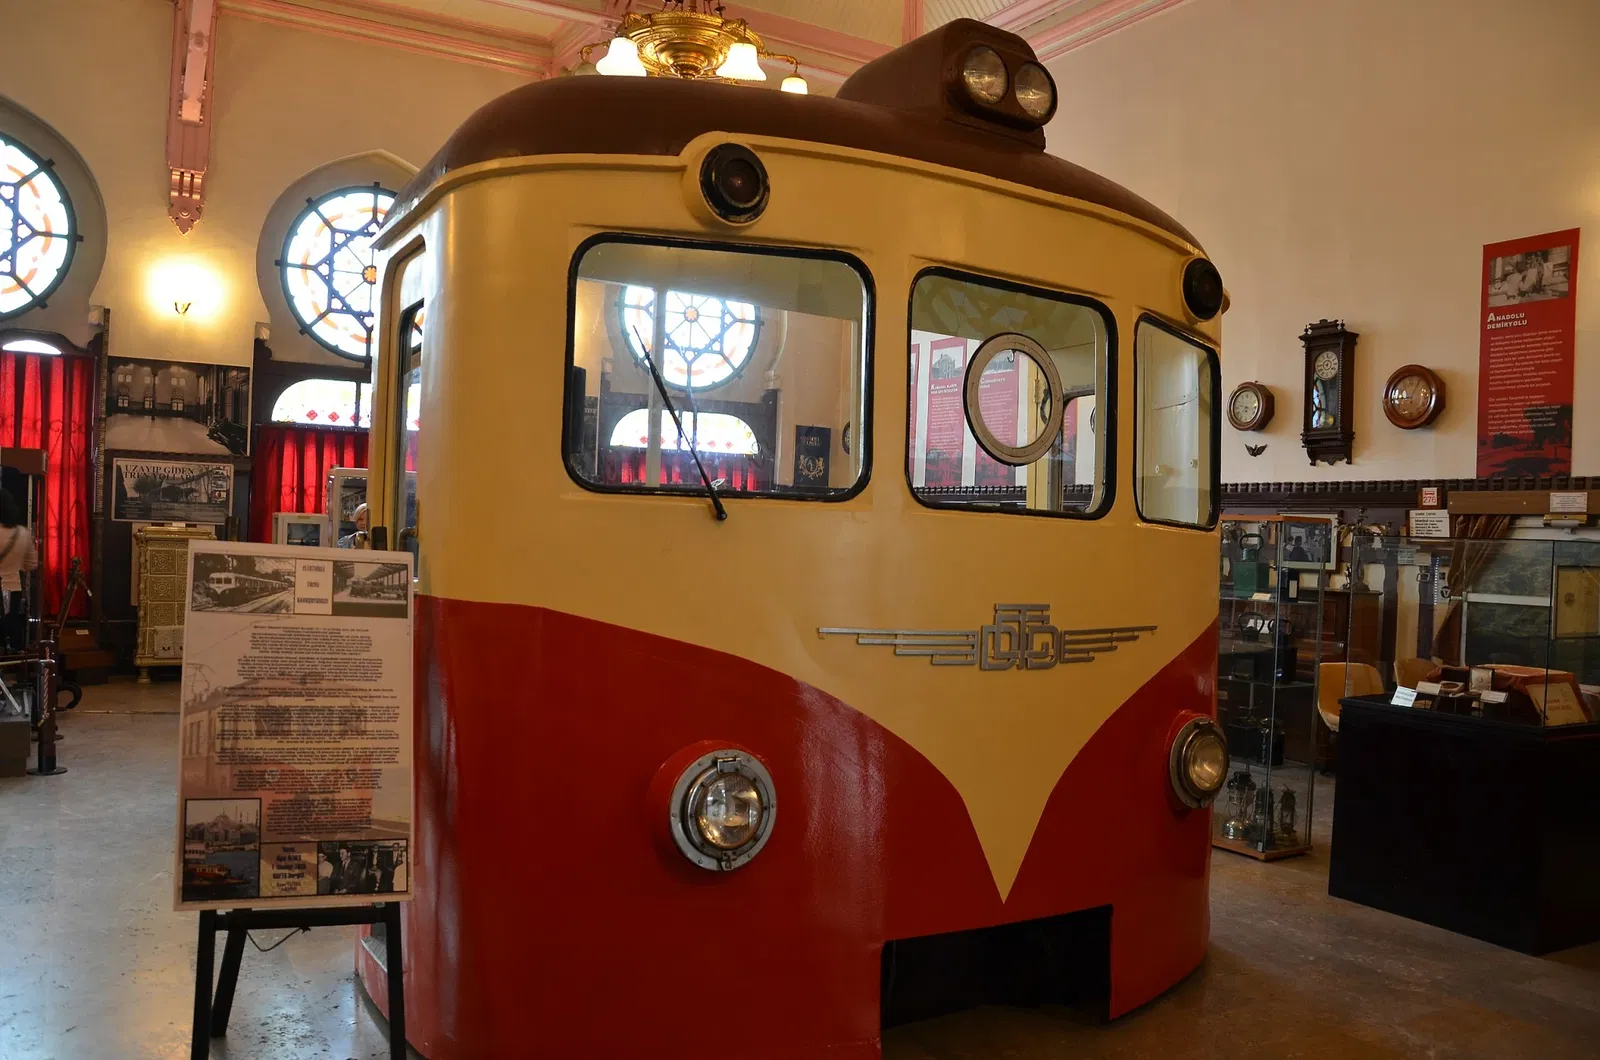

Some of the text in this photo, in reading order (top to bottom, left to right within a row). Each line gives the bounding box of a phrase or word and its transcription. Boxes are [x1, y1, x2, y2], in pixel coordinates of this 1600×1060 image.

[1487, 312, 1525, 322] ANADOLU
[1487, 319, 1528, 329] DEMİRYOLU
[125, 464, 195, 475] UZAYIP GİDEN
[1423, 496, 1437, 504] 276
